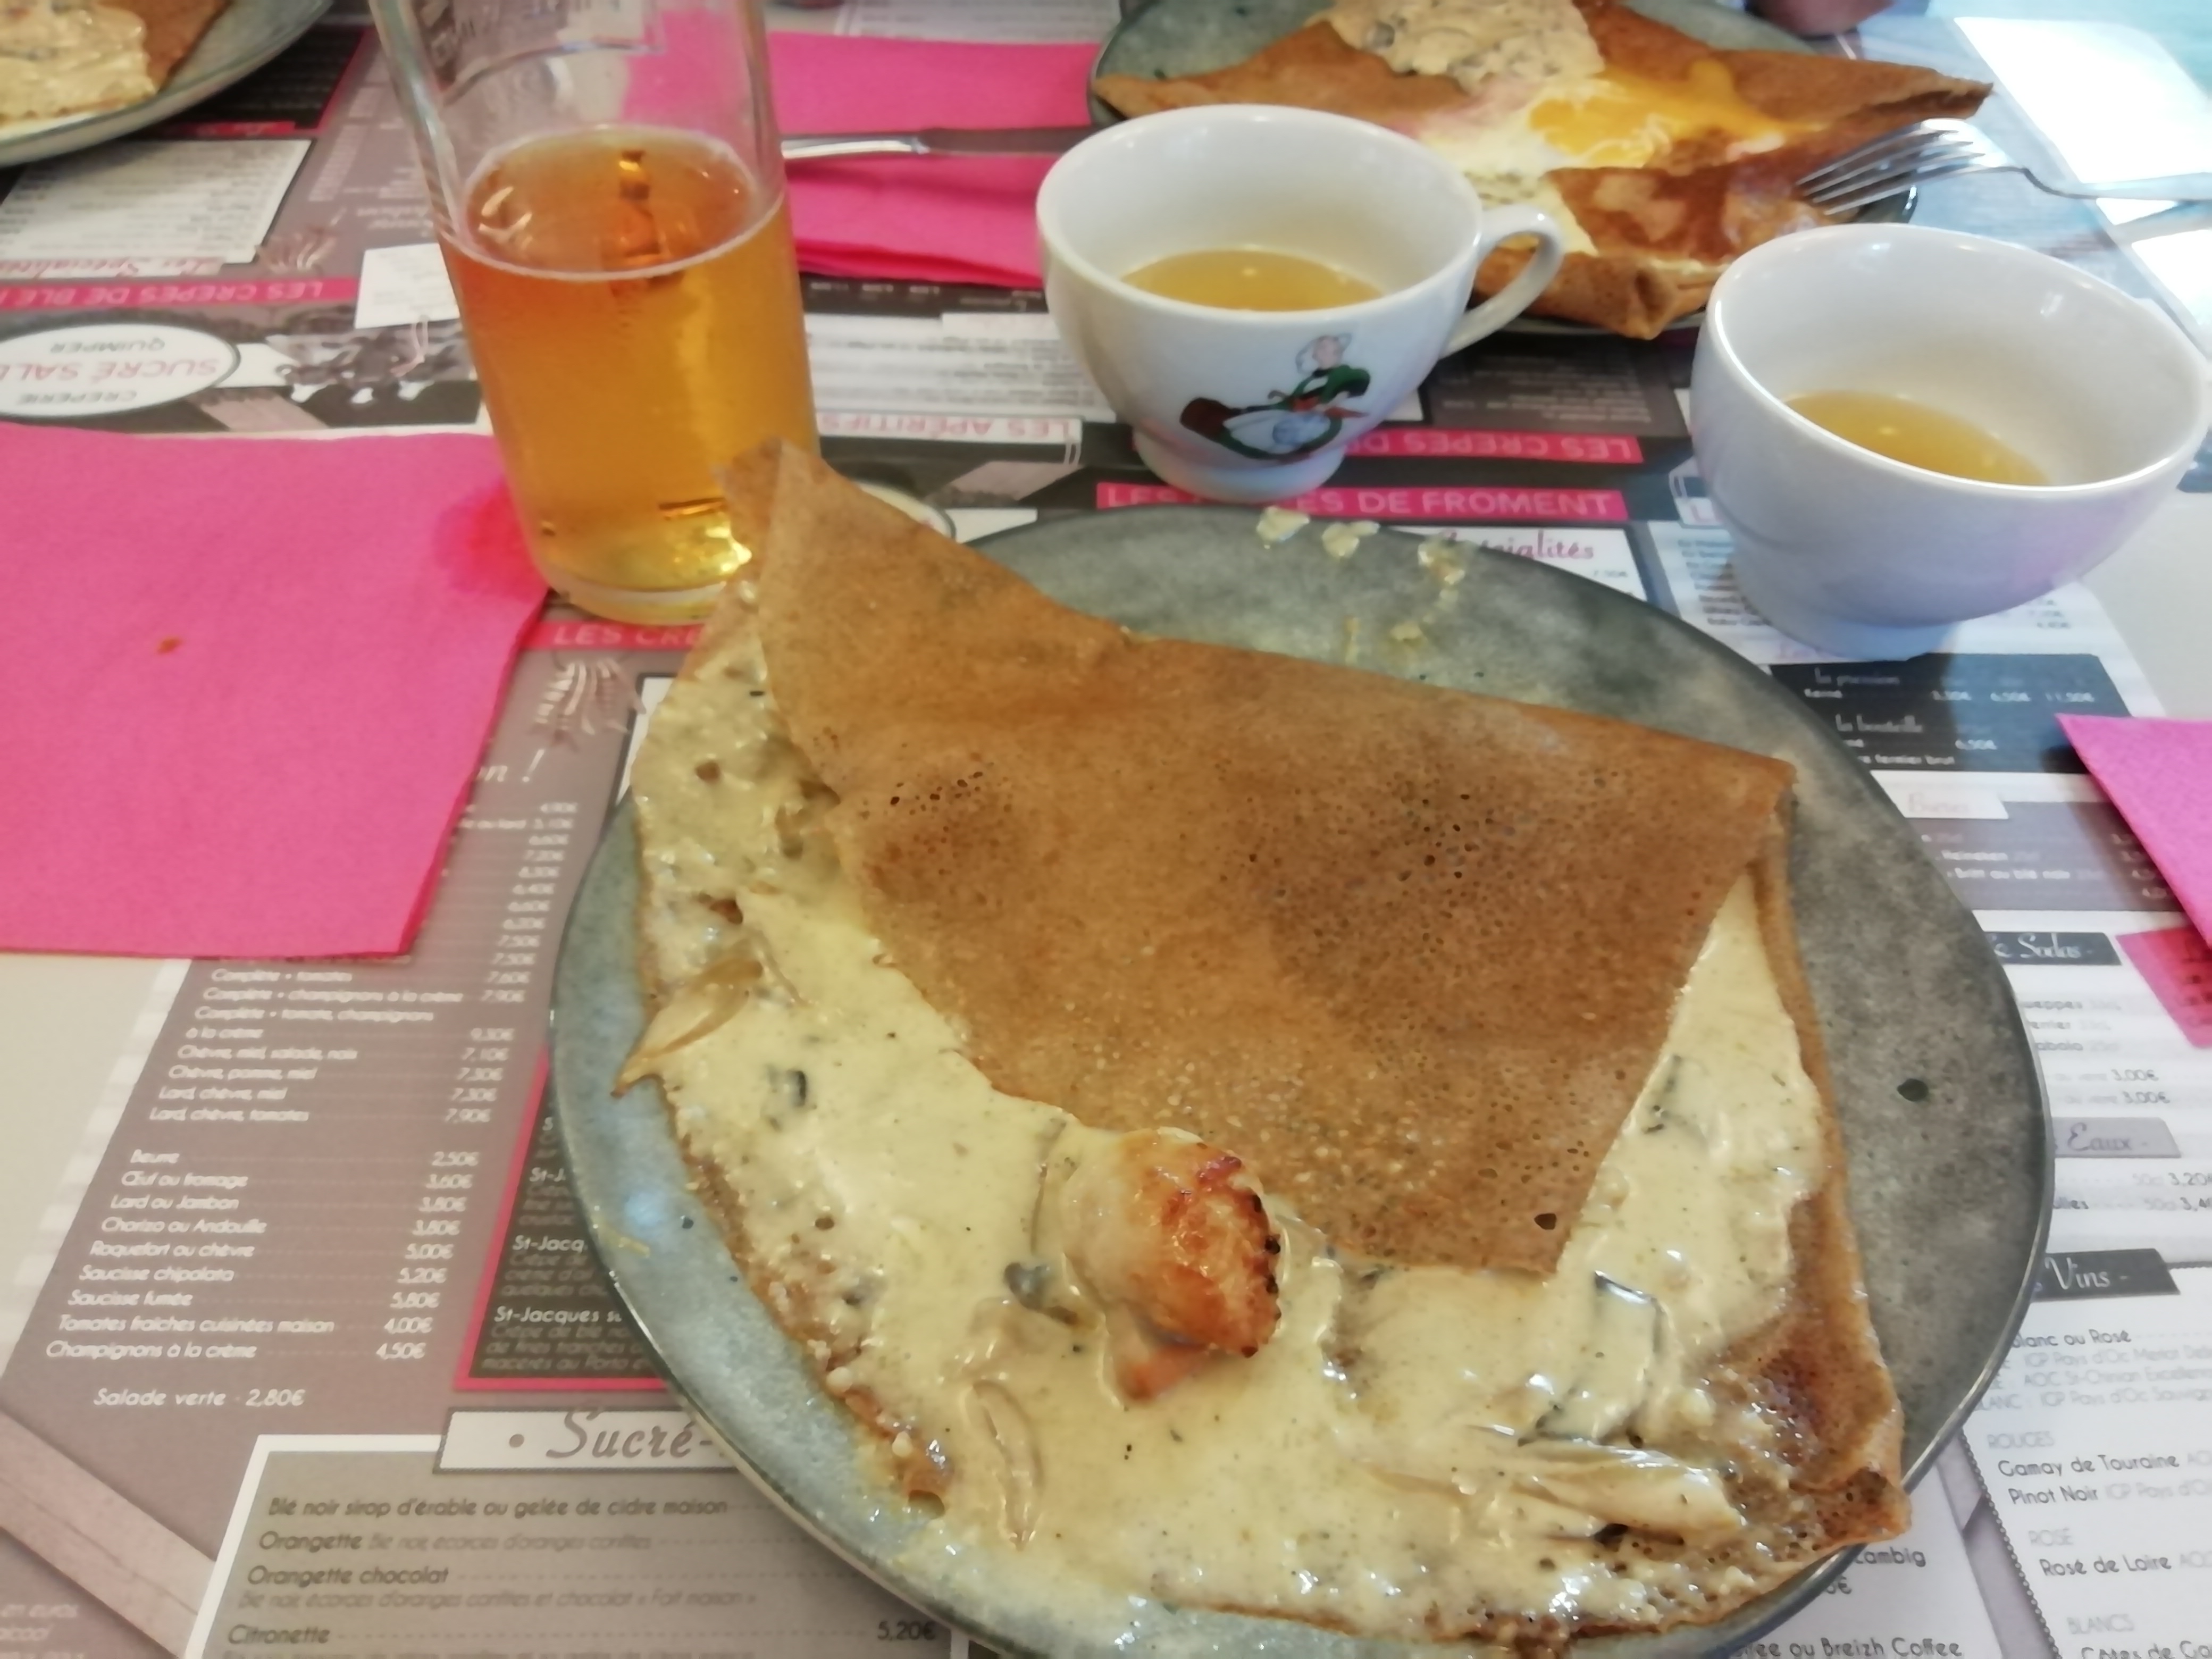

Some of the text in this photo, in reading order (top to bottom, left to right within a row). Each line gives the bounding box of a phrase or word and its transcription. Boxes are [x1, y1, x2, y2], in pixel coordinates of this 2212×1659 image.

[89, 284, 131, 305] DE
[266, 281, 323, 300] LES
[50, 337, 165, 354] QUIMPER
[1561, 437, 1631, 459] LES
[1358, 491, 1411, 513] DE
[1421, 491, 1614, 515] FROMENT
[553, 625, 622, 644] LES
[2066, 1122, 2132, 1152] Eaux
[158, 1176, 180, 1186] ou
[183, 1173, 248, 1189] fromage
[111, 1195, 239, 1209] Lard ou Jambon
[102, 1217, 165, 1233] Chorizo
[89, 1241, 170, 1258] Roquefort
[173, 1245, 195, 1256] ou
[513, 1235, 585, 1254] St-Jacq
[79, 1264, 150, 1280] Saucisse
[154, 1266, 234, 1283] chipolata
[2045, 1256, 2110, 1291] Vins
[68, 1289, 140, 1305] Saucisse
[59, 1314, 127, 1331] Tomates
[277, 1319, 334, 1333] maison
[494, 1306, 599, 1326] St-Jacques
[2064, 1334, 2085, 1346] ou
[46, 1340, 162, 1361] Champignons
[184, 1341, 203, 1358] la
[205, 1345, 257, 1359] crème
[94, 1388, 166, 1406] Salade
[175, 1390, 226, 1406] verte
[2070, 1456, 2096, 1473] de
[2097, 1453, 2180, 1471] Touraine
[2008, 1487, 2056, 1505] Pinot
[2061, 1484, 2099, 1502] Noir
[303, 1499, 340, 1516] noir
[345, 1499, 391, 1519] sirop
[483, 1502, 509, 1516] ou
[575, 1498, 601, 1516] de
[607, 1497, 657, 1516] cidre
[662, 1499, 728, 1516] maison
[258, 1530, 363, 1553] Orangette
[2039, 1553, 2173, 1578] Rosé de Loire
[247, 1565, 449, 1588] Orangette chocolat
[228, 1623, 331, 1645] Citronette
[877, 1619, 937, 1641] 5,20€
[1789, 1637, 1963, 1658] ou Breizh Coffee
